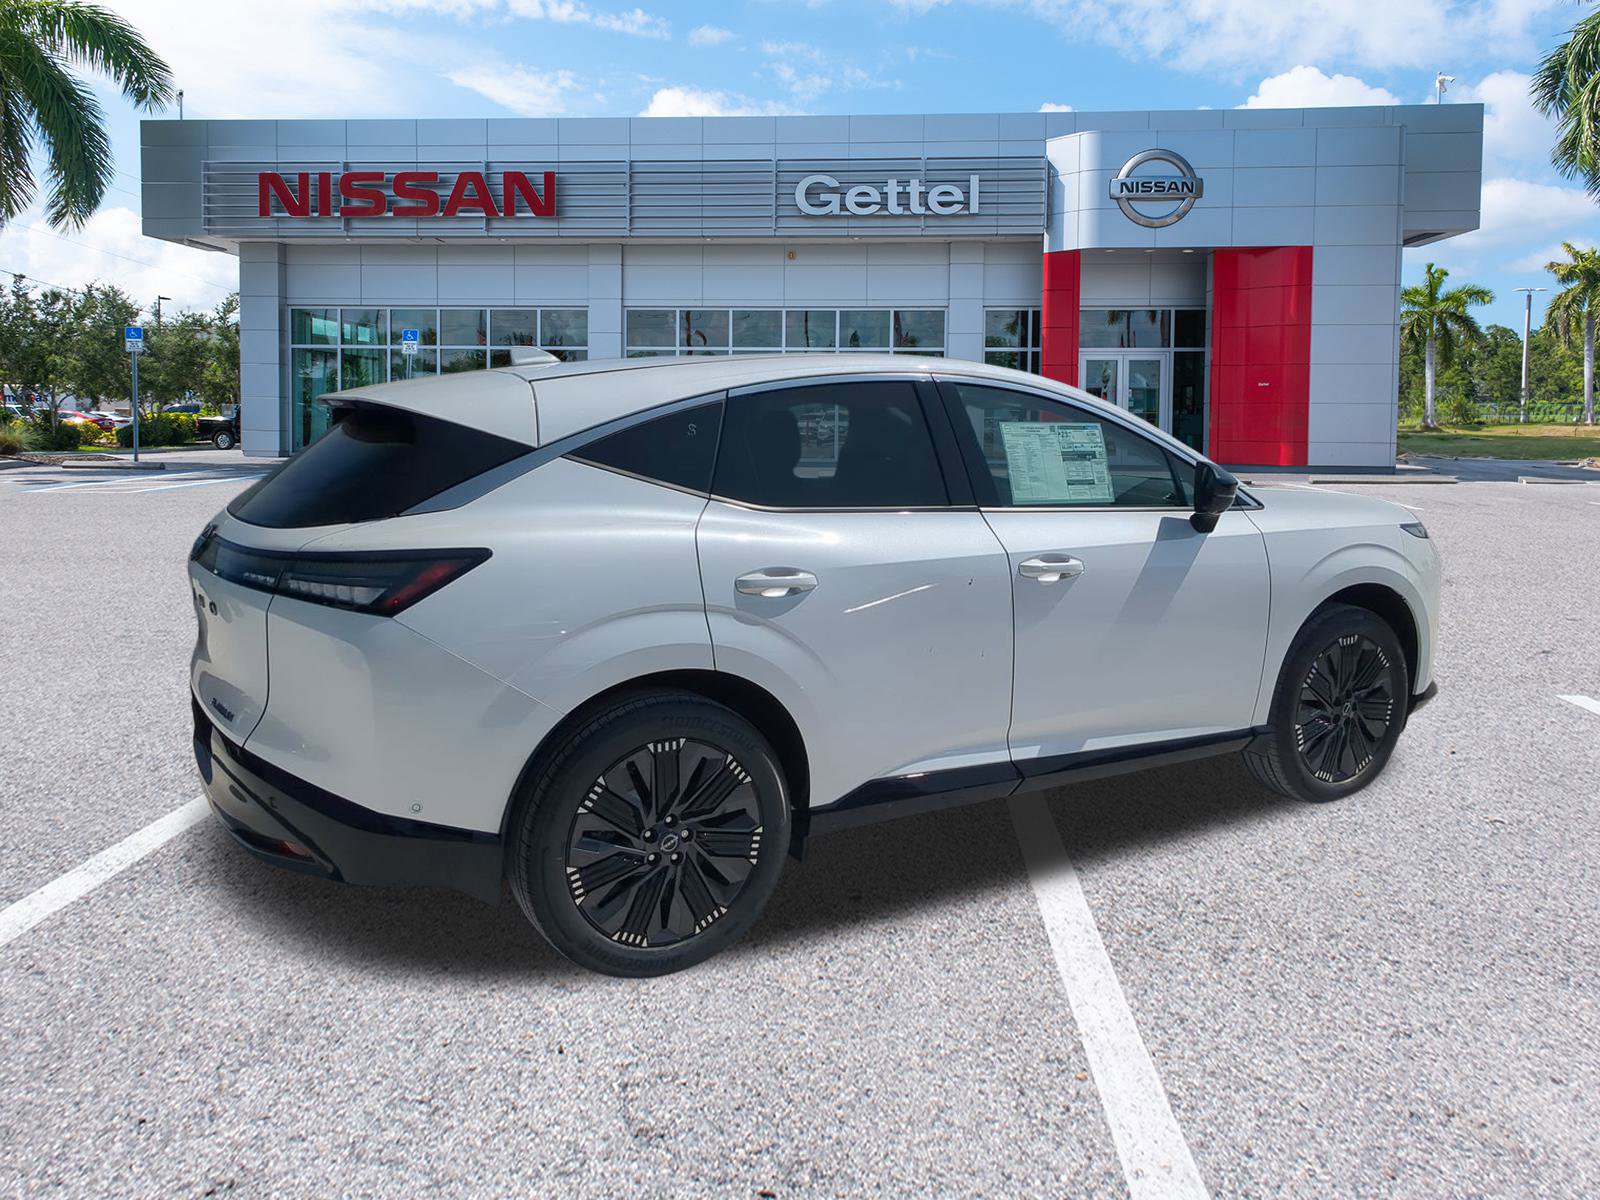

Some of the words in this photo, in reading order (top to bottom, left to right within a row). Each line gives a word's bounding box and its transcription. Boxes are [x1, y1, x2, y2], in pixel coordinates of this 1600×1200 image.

[258, 171, 556, 217] NISSAN
[795, 174, 980, 216] Gettel
[1119, 181, 1194, 194] NISSAN
